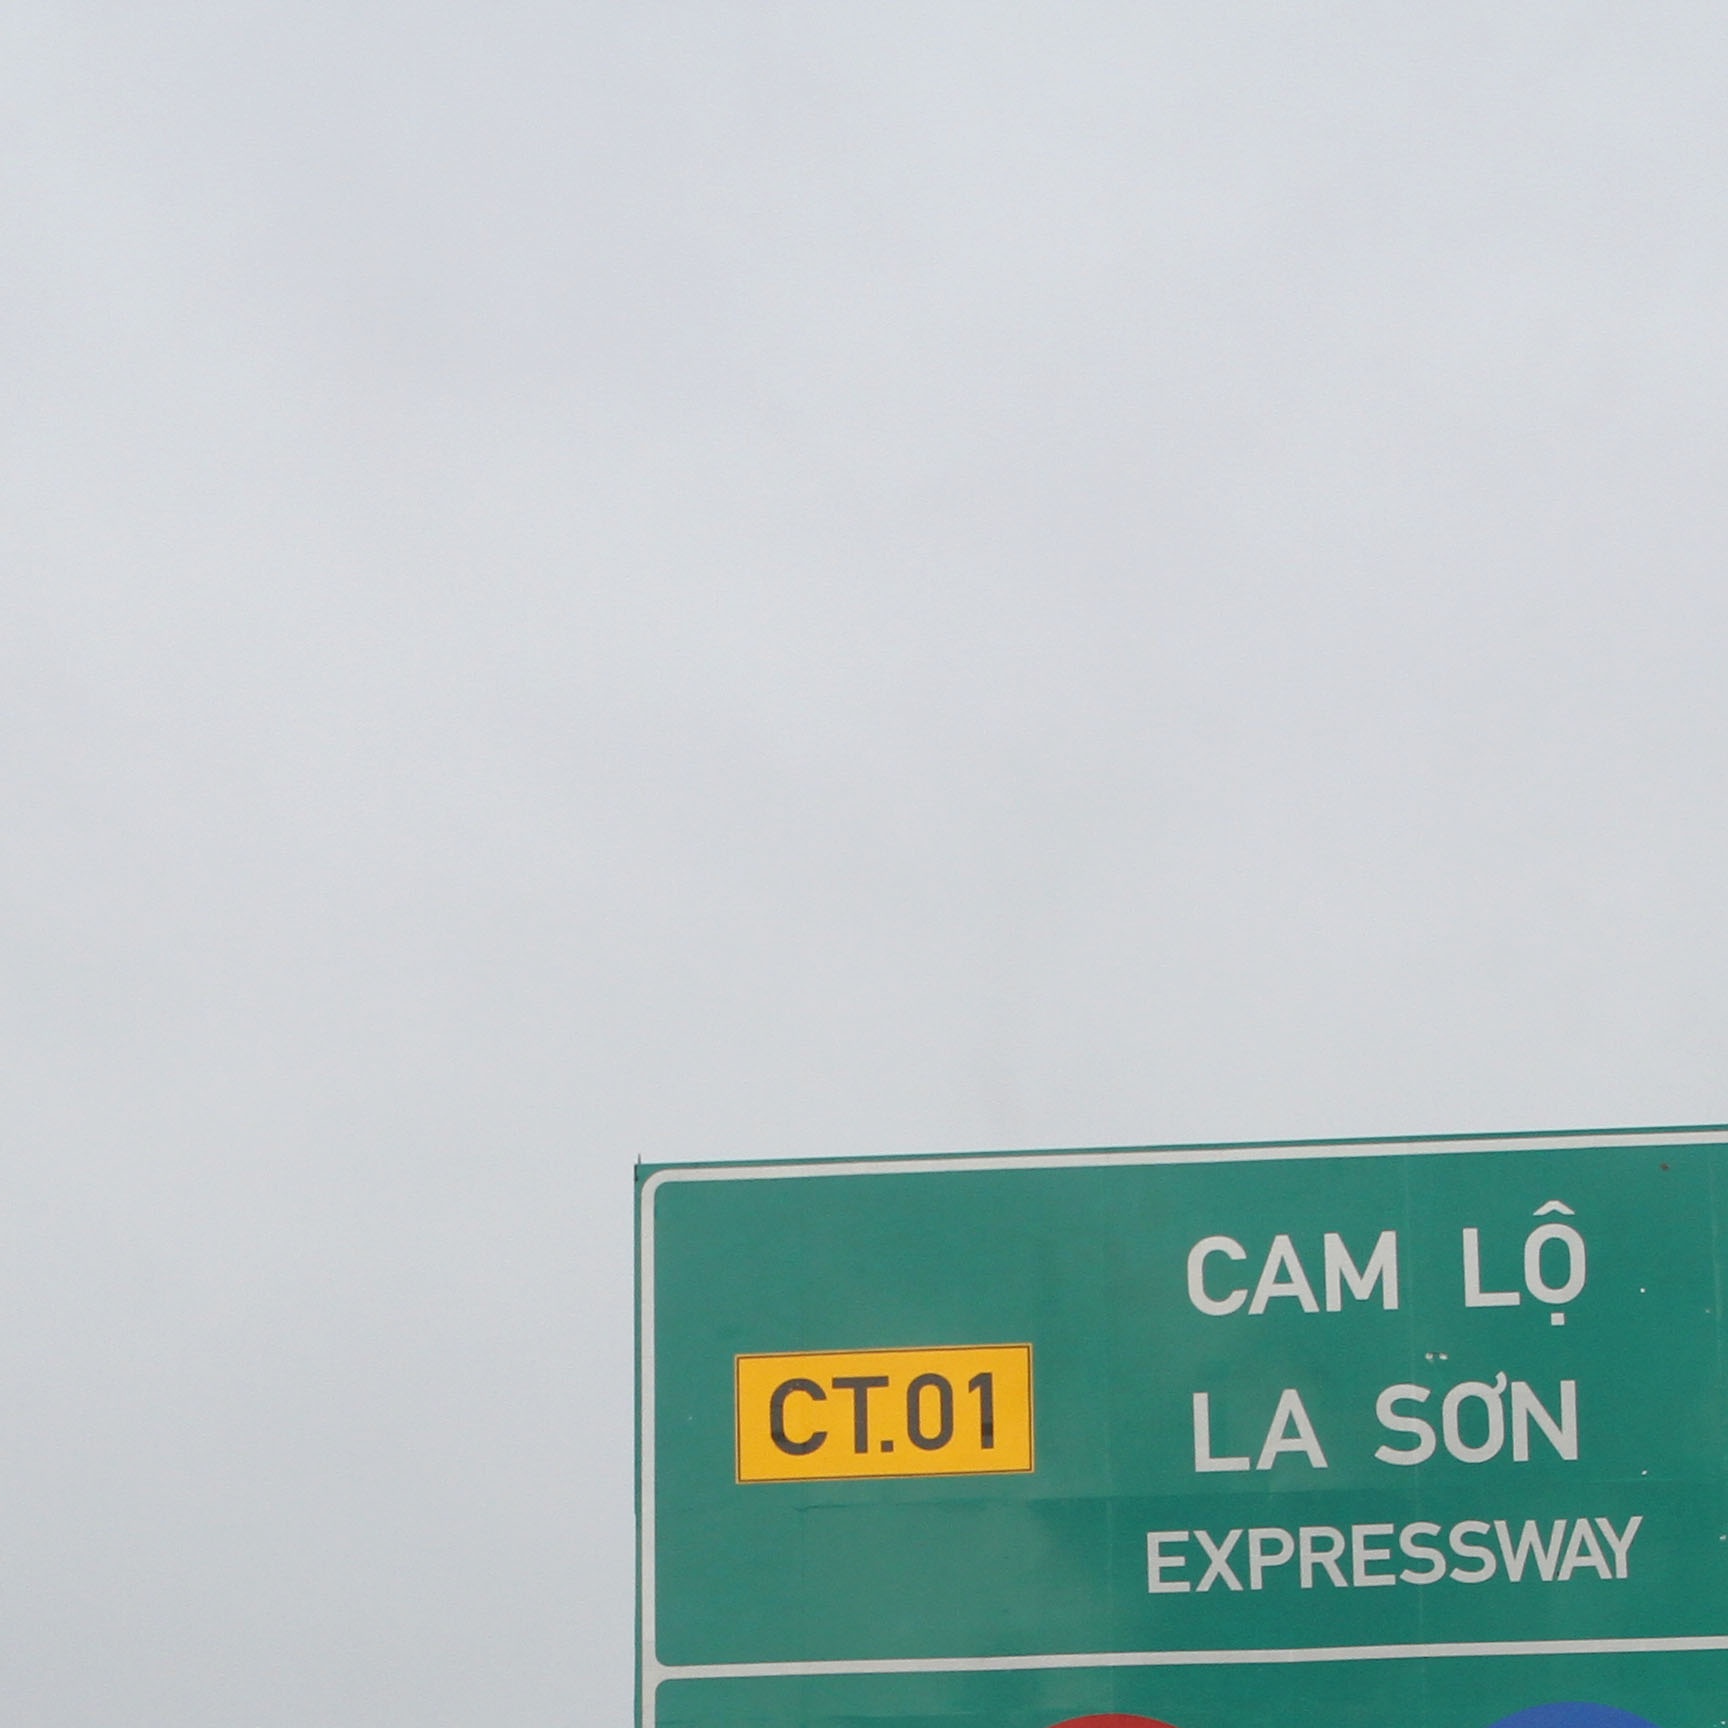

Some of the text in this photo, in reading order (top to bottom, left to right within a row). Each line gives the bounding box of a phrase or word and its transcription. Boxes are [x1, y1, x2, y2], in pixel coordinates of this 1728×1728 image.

[1186, 1199, 1587, 1327] CAM LỘ
[768, 1371, 995, 1456] CT.01
[1191, 1370, 1579, 1473] LA SƠN
[1145, 1515, 1644, 1594] EXPRESSWAY
